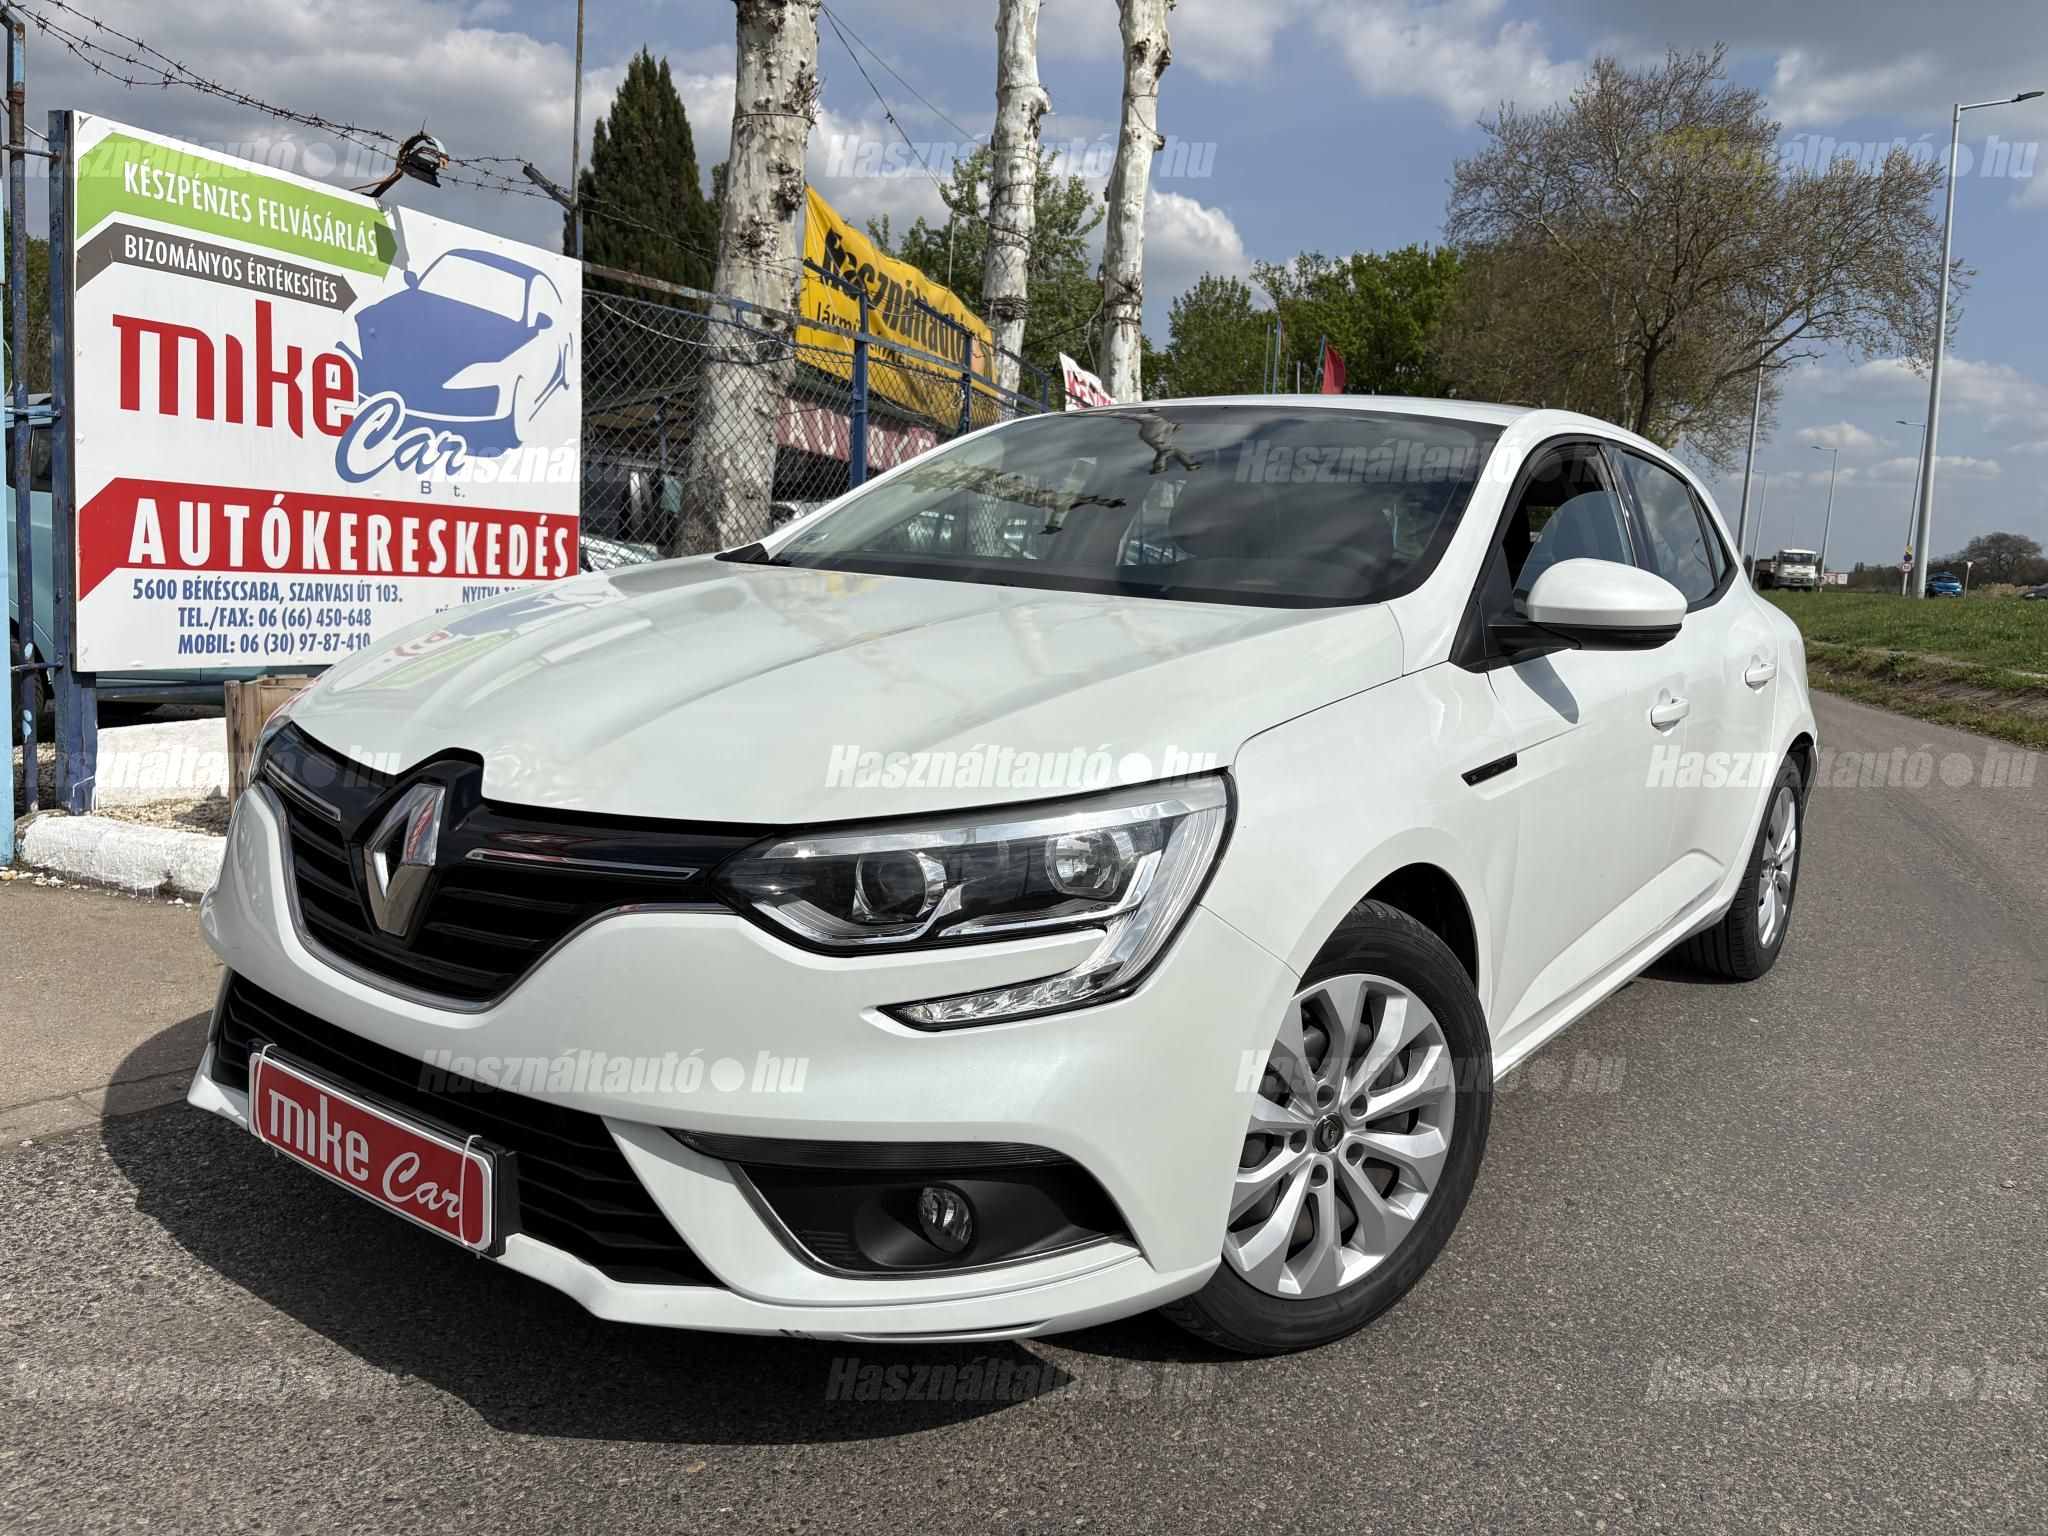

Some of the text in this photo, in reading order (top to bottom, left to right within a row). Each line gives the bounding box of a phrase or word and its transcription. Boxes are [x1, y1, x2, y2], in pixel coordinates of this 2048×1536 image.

[124, 158, 378, 258] KÉSZPÉNZES FELVÁSÁRLÁS
[124, 234, 338, 304] BIZOMÁNYOS ÉRTÉKESÍTÉS
[112, 299, 355, 438] mike
[335, 395, 467, 484] Car
[127, 492, 569, 577] AUTÓKERESKEDÉS
[132, 575, 403, 605] 5600 BÉKÉSCSABA, SZARVASI ÚT 103.
[178, 606, 372, 631] TEL./FAX: 06 (66) 450-648
[177, 633, 371, 656] MOBIL: 06 (30) 97-87-410
[268, 1088, 462, 1219] mike Car
